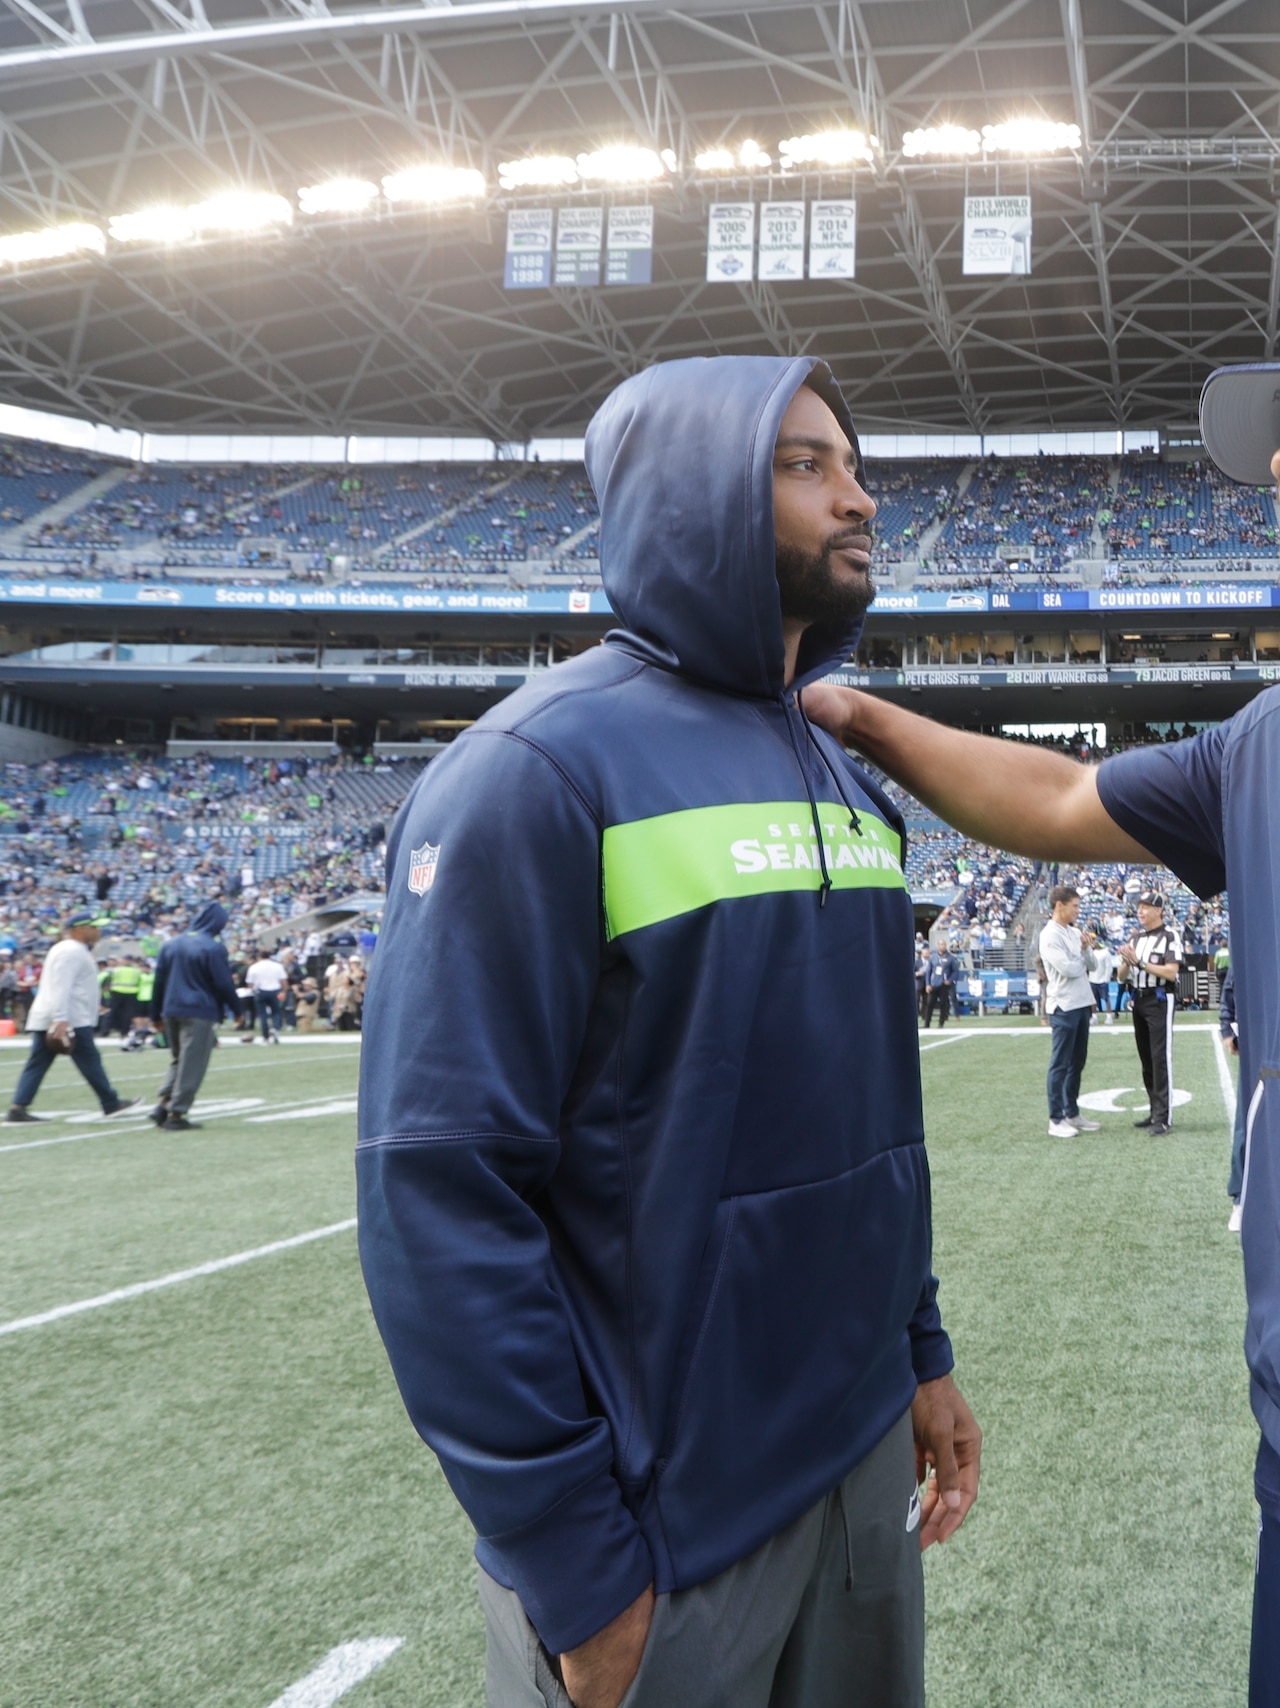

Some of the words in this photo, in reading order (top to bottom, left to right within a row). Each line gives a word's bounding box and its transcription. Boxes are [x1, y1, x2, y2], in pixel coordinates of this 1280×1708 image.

[967, 199, 992, 209] 2013
[994, 199, 1028, 209] WORLD
[967, 208, 1028, 218] CHAMPIONS
[717, 222, 746, 233] 2005
[767, 221, 797, 233] 2013
[818, 220, 848, 231] 2014
[720, 234, 742, 243] NFC
[771, 233, 793, 242] NFC
[822, 232, 844, 241] NFC
[9, 583, 46, 597] and
[48, 586, 103, 599] more!
[215, 589, 265, 603] Score
[268, 590, 297, 606] big
[300, 591, 337, 605] with
[339, 592, 400, 608] tickets,
[402, 594, 445, 609] gear,
[447, 594, 478, 607] and
[481, 595, 528, 608] more!
[874, 595, 918, 607] more!
[992, 595, 1010, 607] DAL
[1043, 594, 1062, 607] SEA
[1100, 592, 1181, 606] COUNTDOWN
[1186, 591, 1202, 604] TO
[1206, 590, 1264, 604] KICKOFF
[404, 673, 434, 685] RING
[438, 674, 452, 685] OF
[455, 674, 497, 686] HONOR
[905, 673, 928, 685] PETE
[928, 673, 960, 685] GROSS
[1006, 671, 1021, 684] 28
[1023, 671, 1047, 684] CURT
[1048, 671, 1087, 684] WARNER
[1135, 670, 1150, 682] 79
[1151, 670, 1178, 682] JACOB
[1181, 669, 1211, 681] GREEN
[1258, 667, 1275, 680] 45
[200, 826, 252, 837] DELTA
[412, 865, 433, 888] NFL
